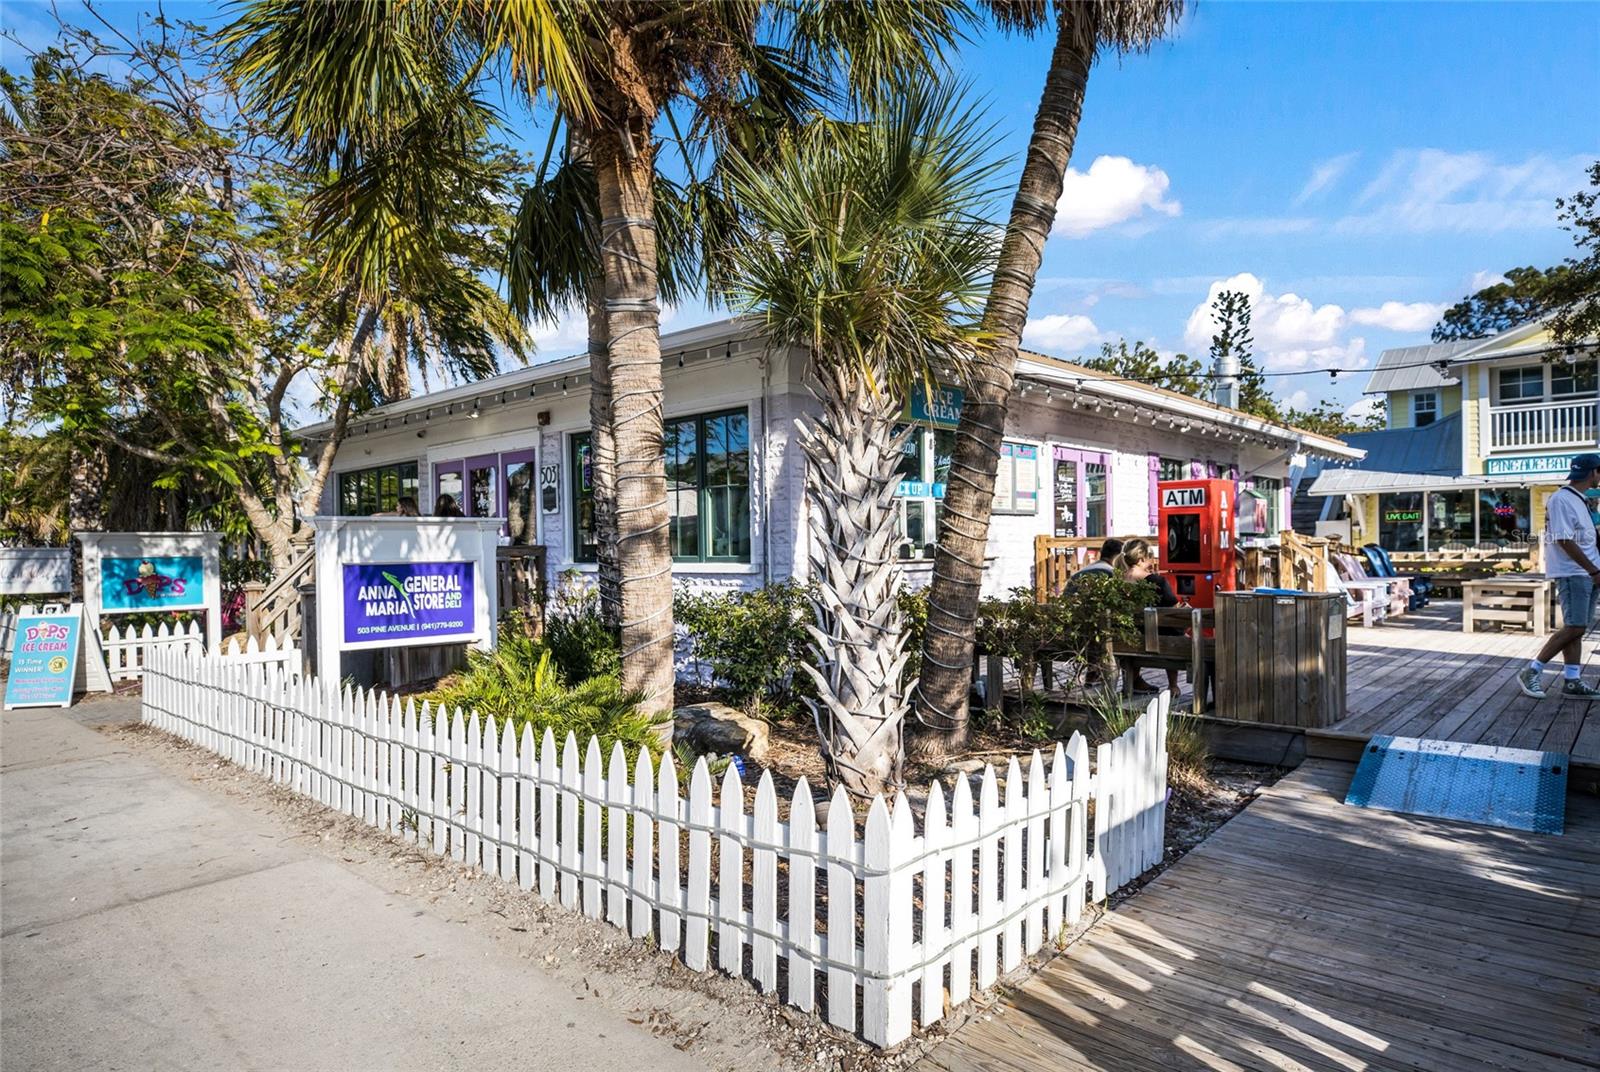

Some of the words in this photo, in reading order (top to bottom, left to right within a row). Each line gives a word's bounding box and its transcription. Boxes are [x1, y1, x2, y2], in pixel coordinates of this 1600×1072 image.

[540, 465, 557, 485] 503
[1165, 489, 1203, 506] ATM
[1220, 490, 1229, 549] ATM
[404, 575, 461, 593] GENERAL
[357, 585, 397, 601] ANNA
[414, 592, 444, 610] STORE
[445, 592, 463, 600] AND
[365, 600, 409, 617] MARIA
[445, 600, 462, 609] DELI
[357, 627, 370, 635] 503
[370, 626, 387, 634] PINE
[387, 624, 416, 633] AVENUE
[22, 642, 36, 652] ICE
[38, 641, 69, 652] CREAM
